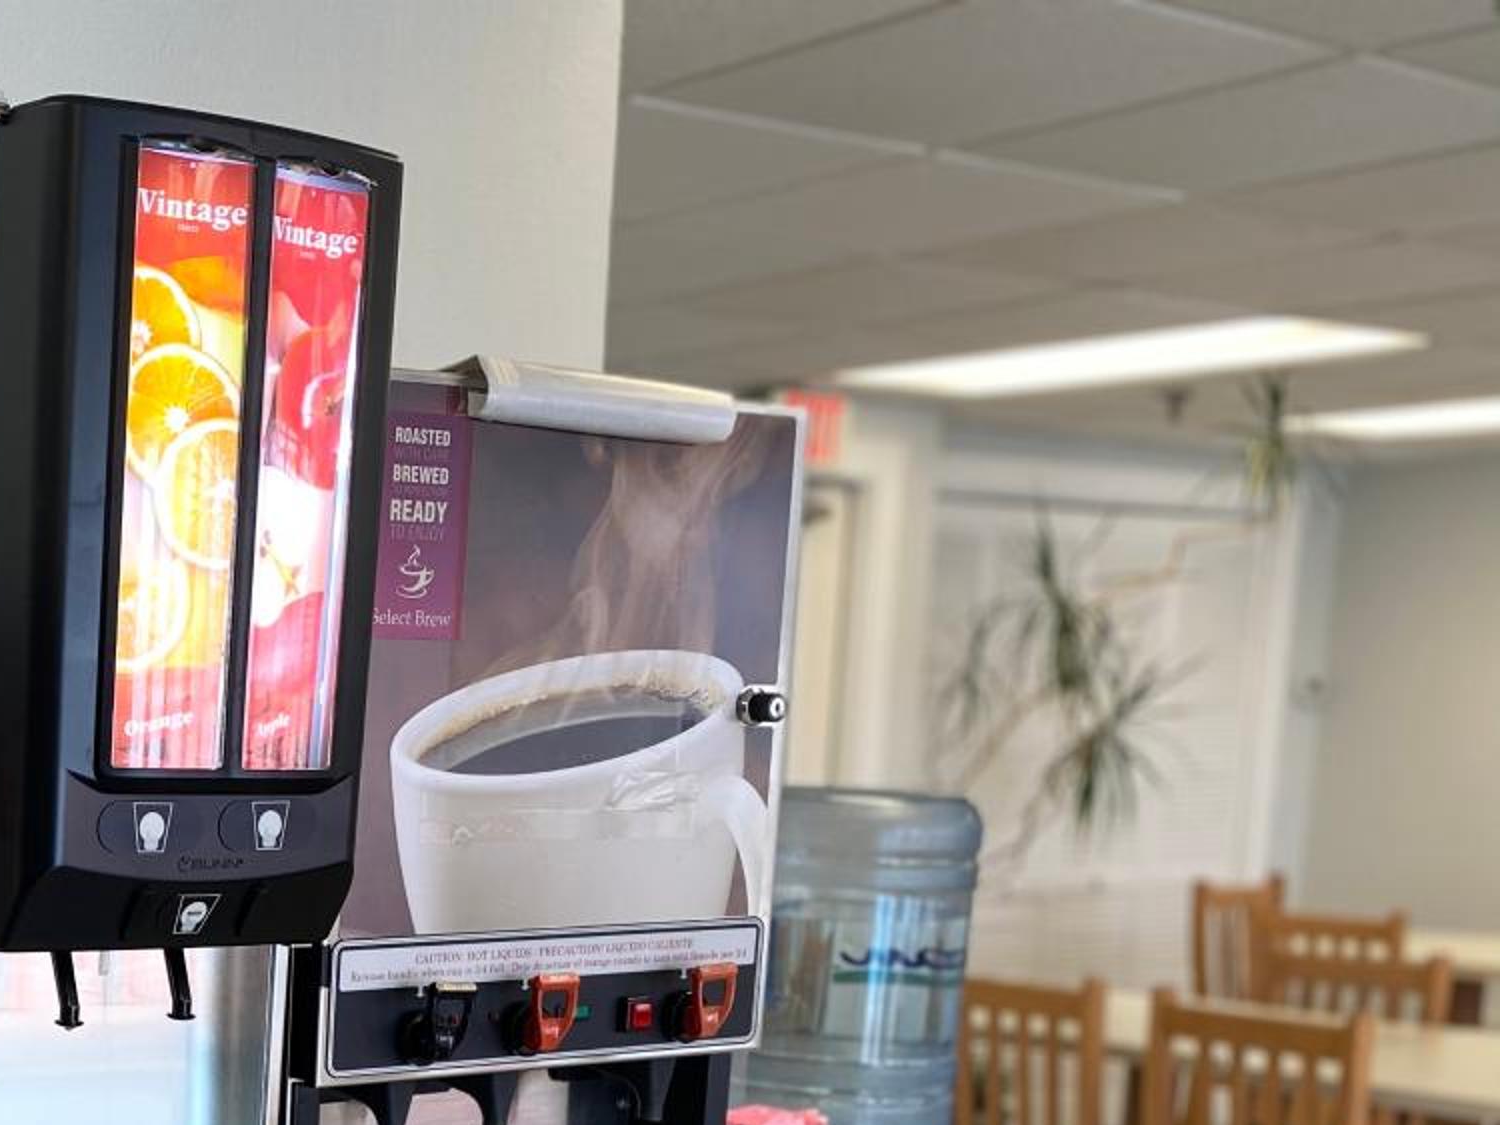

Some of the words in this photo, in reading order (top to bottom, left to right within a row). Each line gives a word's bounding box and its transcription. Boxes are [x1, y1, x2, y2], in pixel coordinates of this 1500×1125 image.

[138, 188, 248, 231] Vintage
[274, 215, 357, 258] Vintage
[395, 427, 451, 446] ROASTED
[393, 464, 449, 485] BREWED
[389, 500, 448, 524] READY
[415, 609, 450, 628] Brew
